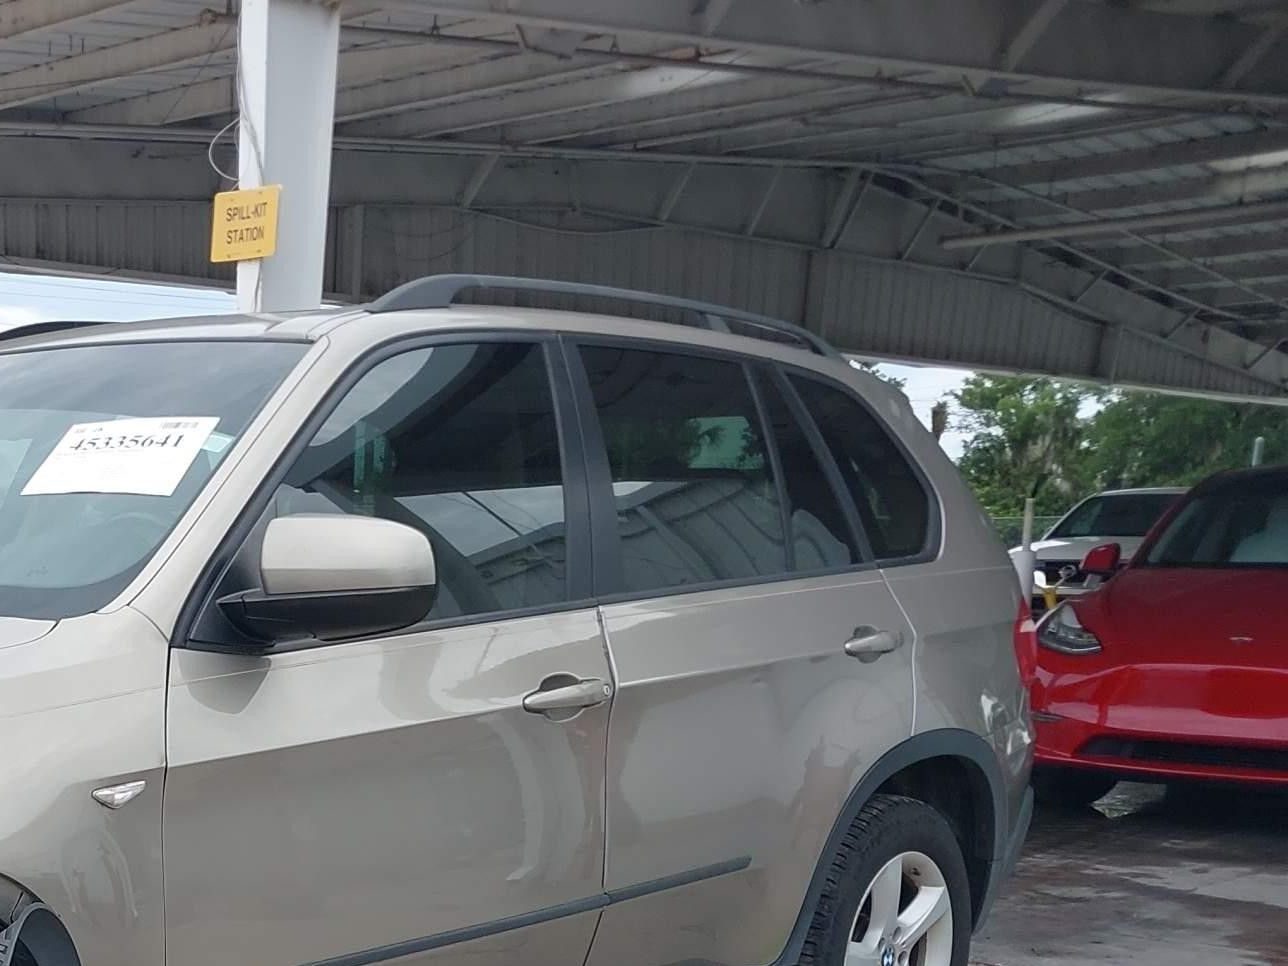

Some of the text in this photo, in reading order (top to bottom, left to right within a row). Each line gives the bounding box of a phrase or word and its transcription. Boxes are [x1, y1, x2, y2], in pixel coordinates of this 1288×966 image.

[226, 202, 267, 222] SPILL-KIT
[226, 226, 264, 244] STATION
[70, 434, 185, 450] 45335641
